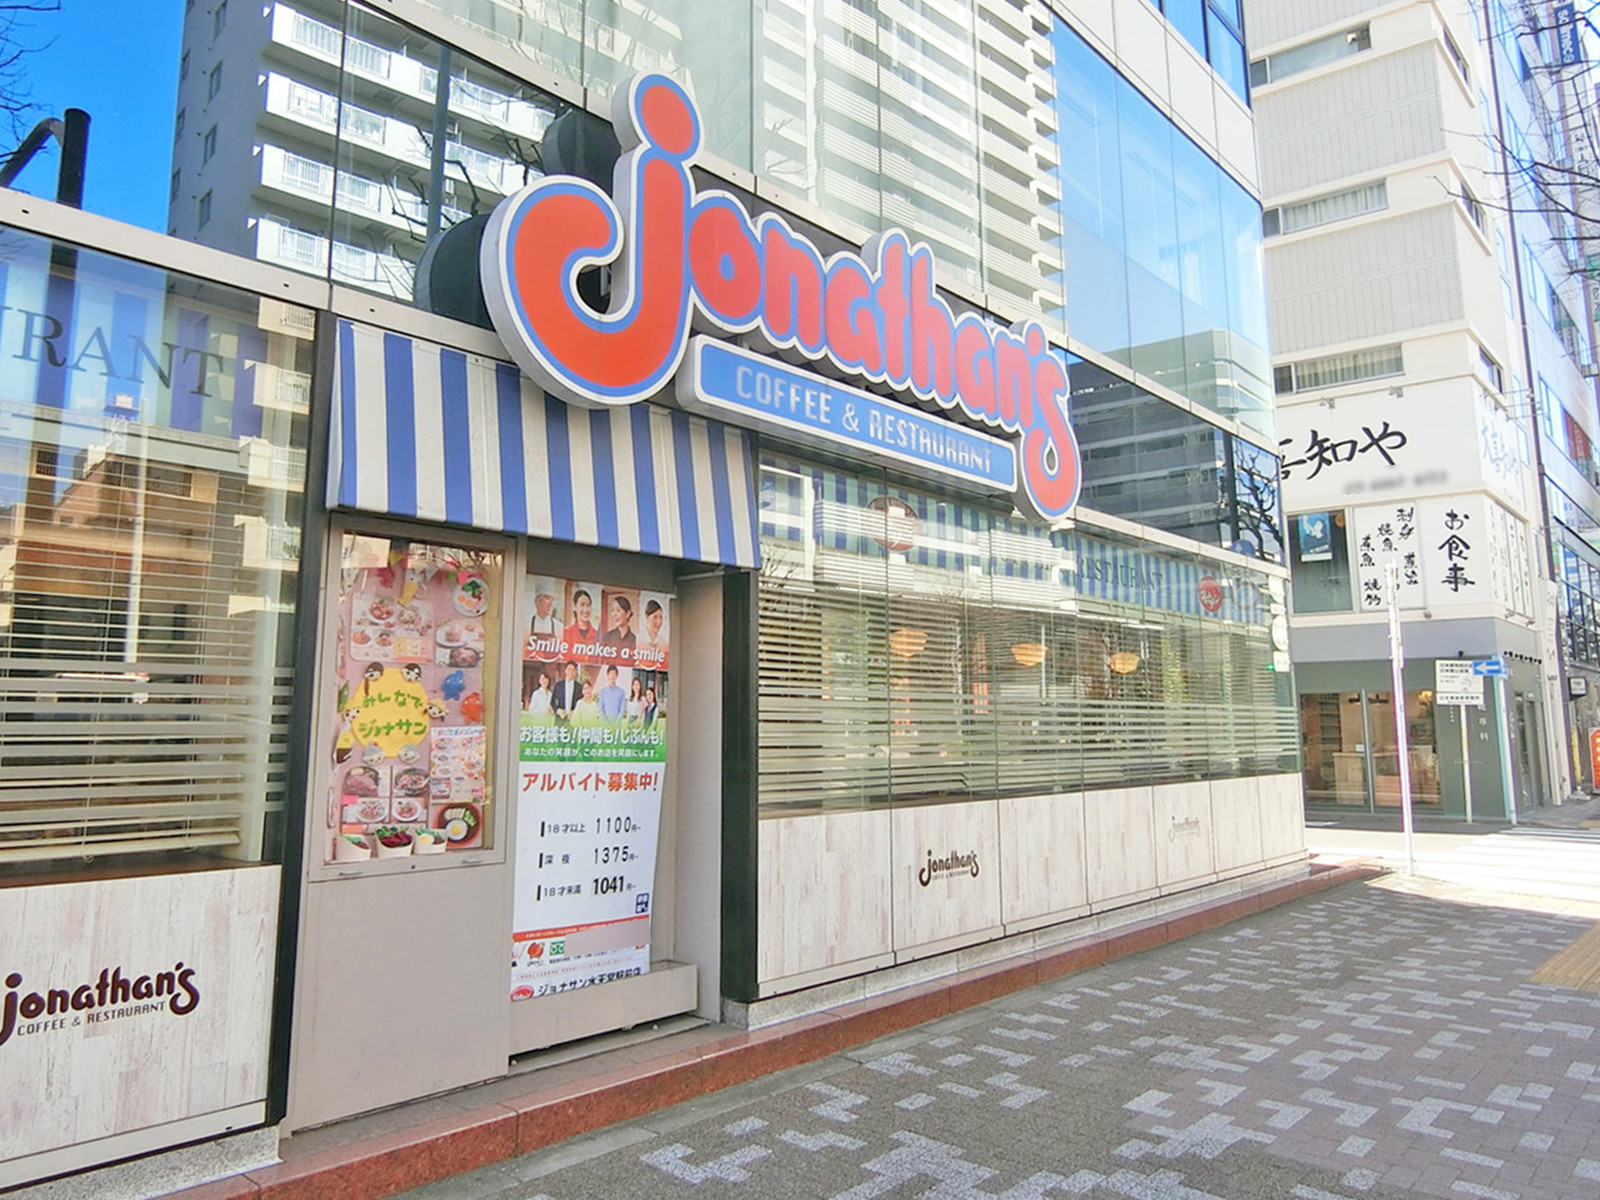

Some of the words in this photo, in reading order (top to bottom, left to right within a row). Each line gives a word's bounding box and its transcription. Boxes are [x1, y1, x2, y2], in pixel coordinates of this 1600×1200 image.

[500, 73, 1080, 518] jonathan's
[0, 306, 223, 397] RANT
[735, 364, 832, 424] COFFEE
[842, 403, 860, 432] &
[869, 409, 993, 474] RESTAURANT
[1438, 509, 1475, 592] お食事
[527, 635, 568, 654] Smile
[573, 642, 617, 657] makes
[621, 649, 631, 659] a
[633, 648, 665, 662] smile
[362, 690, 424, 708] みんなで
[358, 719, 428, 739] ジョナサン
[522, 772, 659, 792] アルバイト募集中!
[918, 849, 980, 888] jonathan's
[0, 961, 201, 1047] jonathan's
[17, 1018, 67, 1036] COFFEE
[72, 1016, 81, 1027] &
[87, 1001, 166, 1024] RESTAURANT
